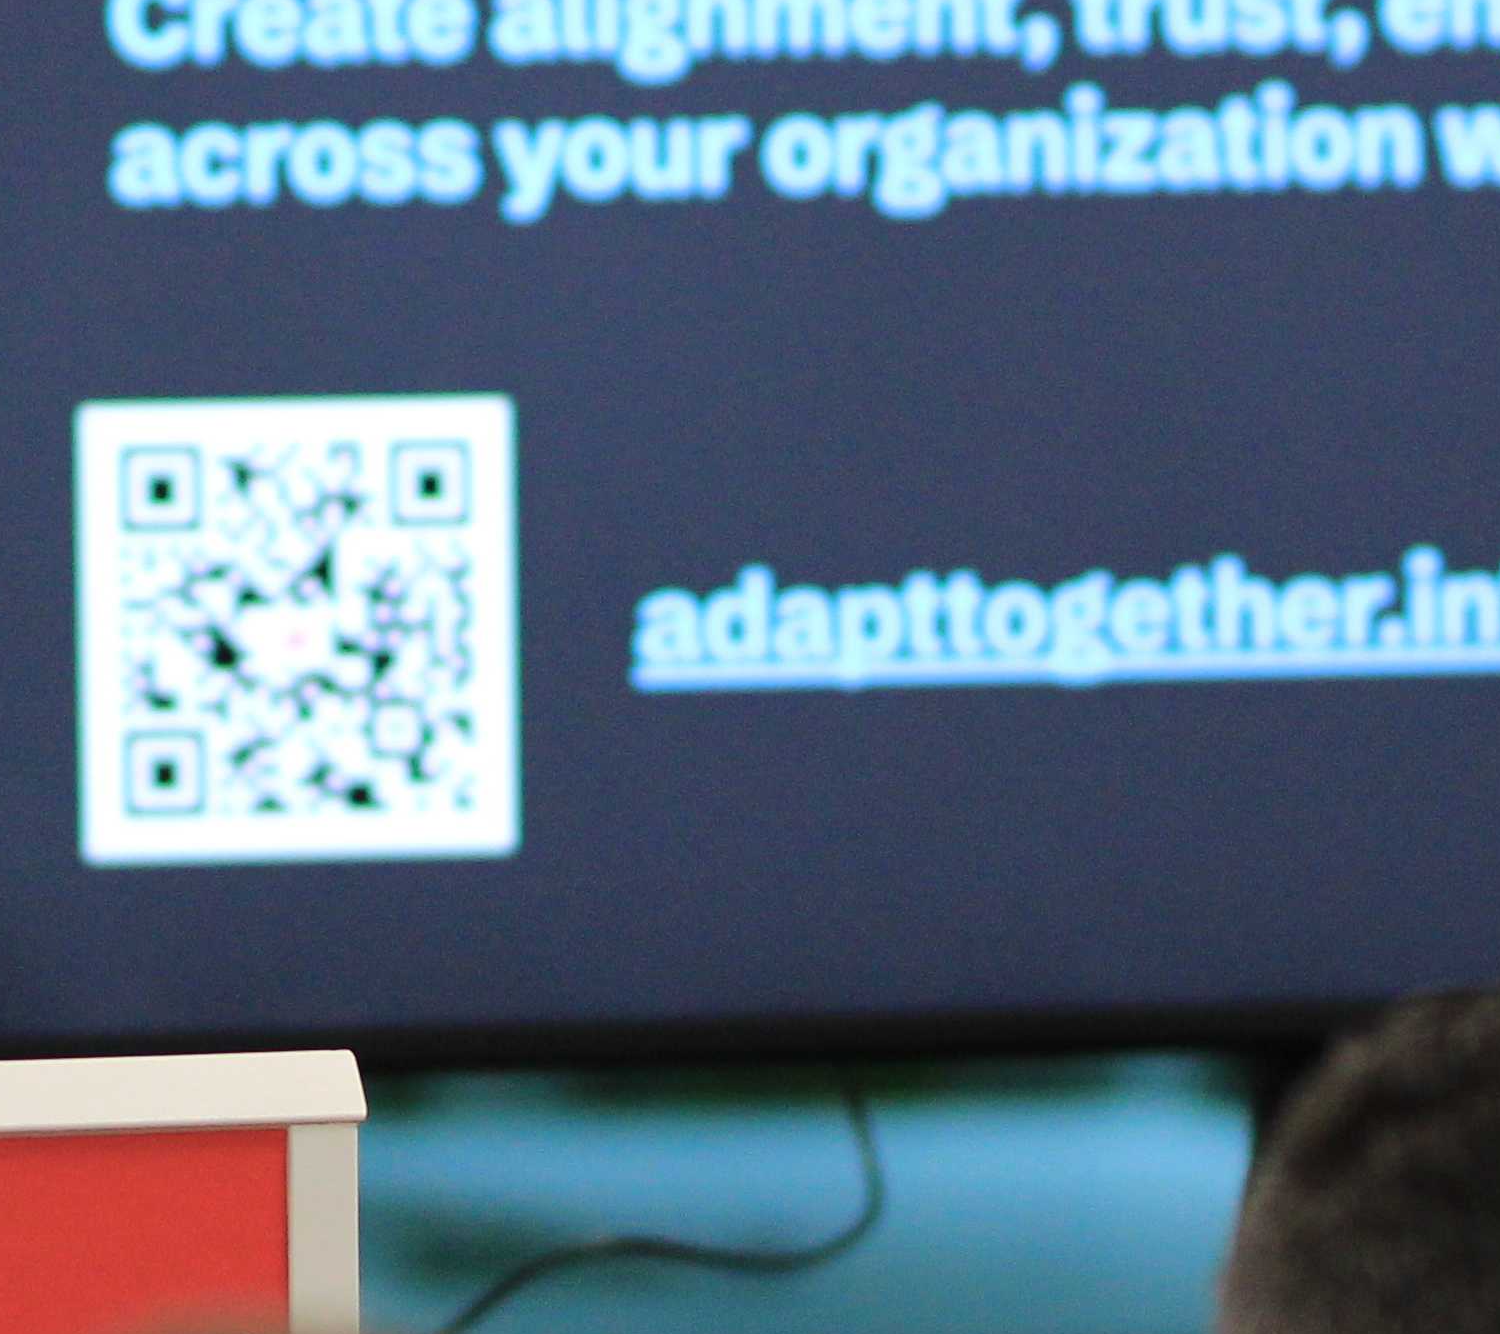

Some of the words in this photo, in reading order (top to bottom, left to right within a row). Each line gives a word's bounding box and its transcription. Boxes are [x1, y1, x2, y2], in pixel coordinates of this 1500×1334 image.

[106, 116, 485, 209] across
[490, 112, 754, 225] your
[757, 79, 1427, 221] organization
